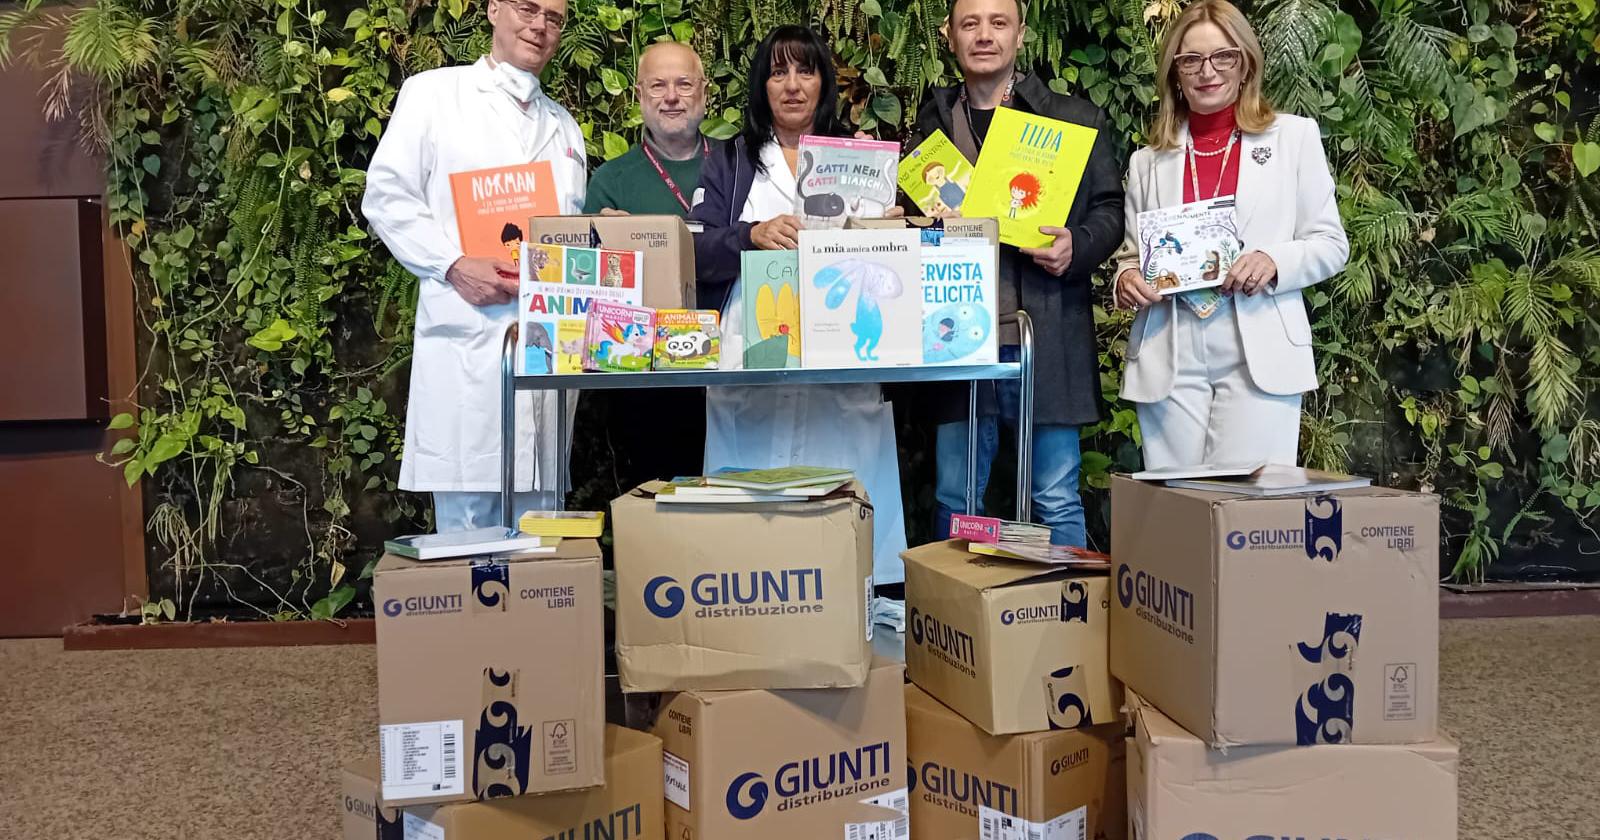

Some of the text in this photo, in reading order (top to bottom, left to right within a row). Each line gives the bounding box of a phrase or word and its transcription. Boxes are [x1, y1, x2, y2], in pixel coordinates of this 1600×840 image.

[1020, 122, 1062, 152] TILDA
[816, 164, 880, 178] GATTI NERI
[472, 172, 535, 202] NORMAN
[807, 175, 884, 191] GATTI BIANCHI
[947, 224, 983, 232] CONTIENE
[554, 233, 590, 243] GIUNT
[630, 232, 667, 241] CONTIENE
[648, 240, 668, 248] LIBRI
[812, 242, 908, 254] La mia amica ombra
[599, 306, 633, 318] UNICORNI
[1248, 529, 1304, 545] GIUNTI
[1361, 526, 1414, 537] CONTIENE
[1387, 538, 1414, 549] LIBRI
[520, 586, 575, 600] CONTIENE
[691, 568, 823, 606] GIUNTI
[404, 594, 462, 611] GIUNTI
[547, 597, 575, 609] LIBRI
[1135, 570, 1194, 630] GIUNTI
[694, 602, 824, 618] distribuzione
[1016, 604, 1059, 620] GIUNTI
[1136, 606, 1194, 645] distribuzione
[924, 614, 975, 667] GIUNTI
[927, 644, 976, 679] distribuzione
[668, 709, 692, 727] CONTIENE
[678, 724, 691, 737] LIBRI
[1061, 748, 1089, 768] GIUNTI
[775, 741, 890, 798] GIUNTI
[777, 777, 890, 812] distribuzione
[921, 761, 1018, 817] GIUNTI
[923, 792, 979, 819] distribu
